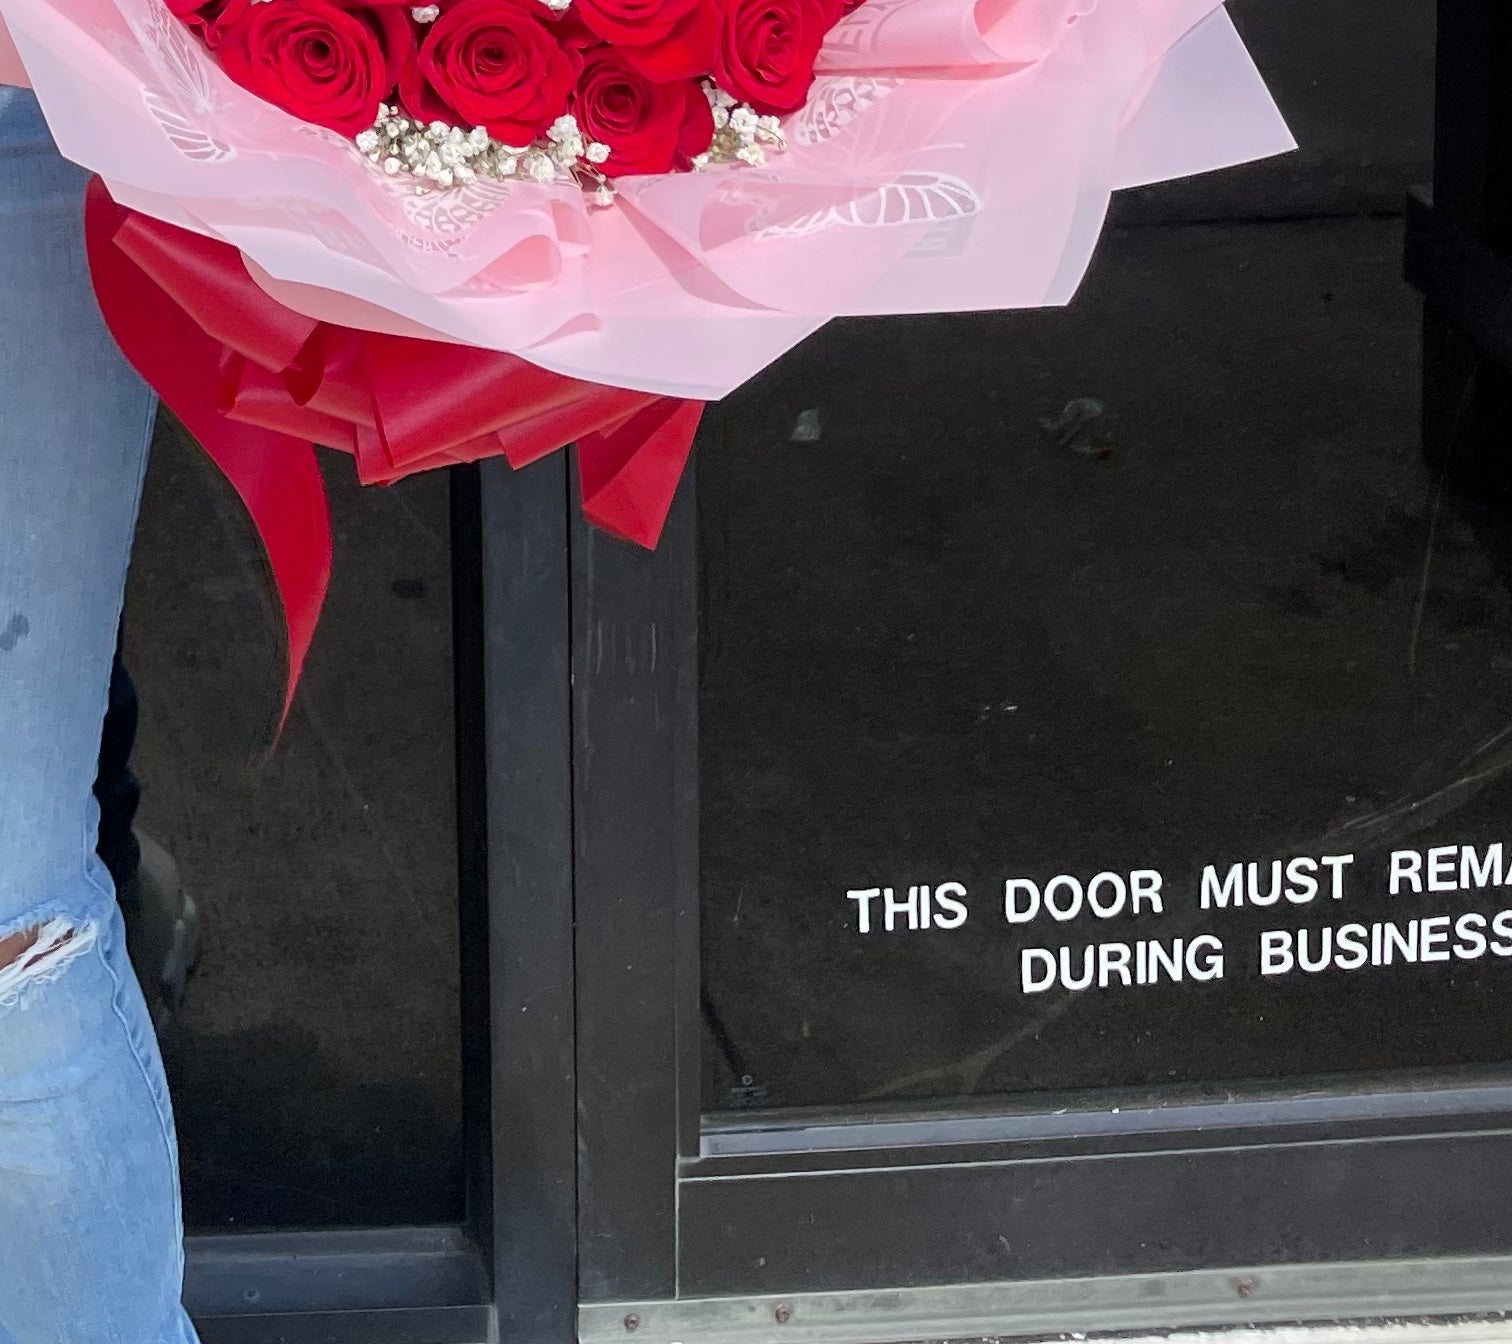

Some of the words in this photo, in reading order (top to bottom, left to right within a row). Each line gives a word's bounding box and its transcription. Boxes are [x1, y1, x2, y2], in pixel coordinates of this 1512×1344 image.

[847, 881, 968, 933] THIS
[1005, 868, 1164, 924] DOOR
[1200, 854, 1355, 909] MUST
[1021, 935, 1224, 993] DURING
[1261, 909, 1512, 976] BUSINESS
